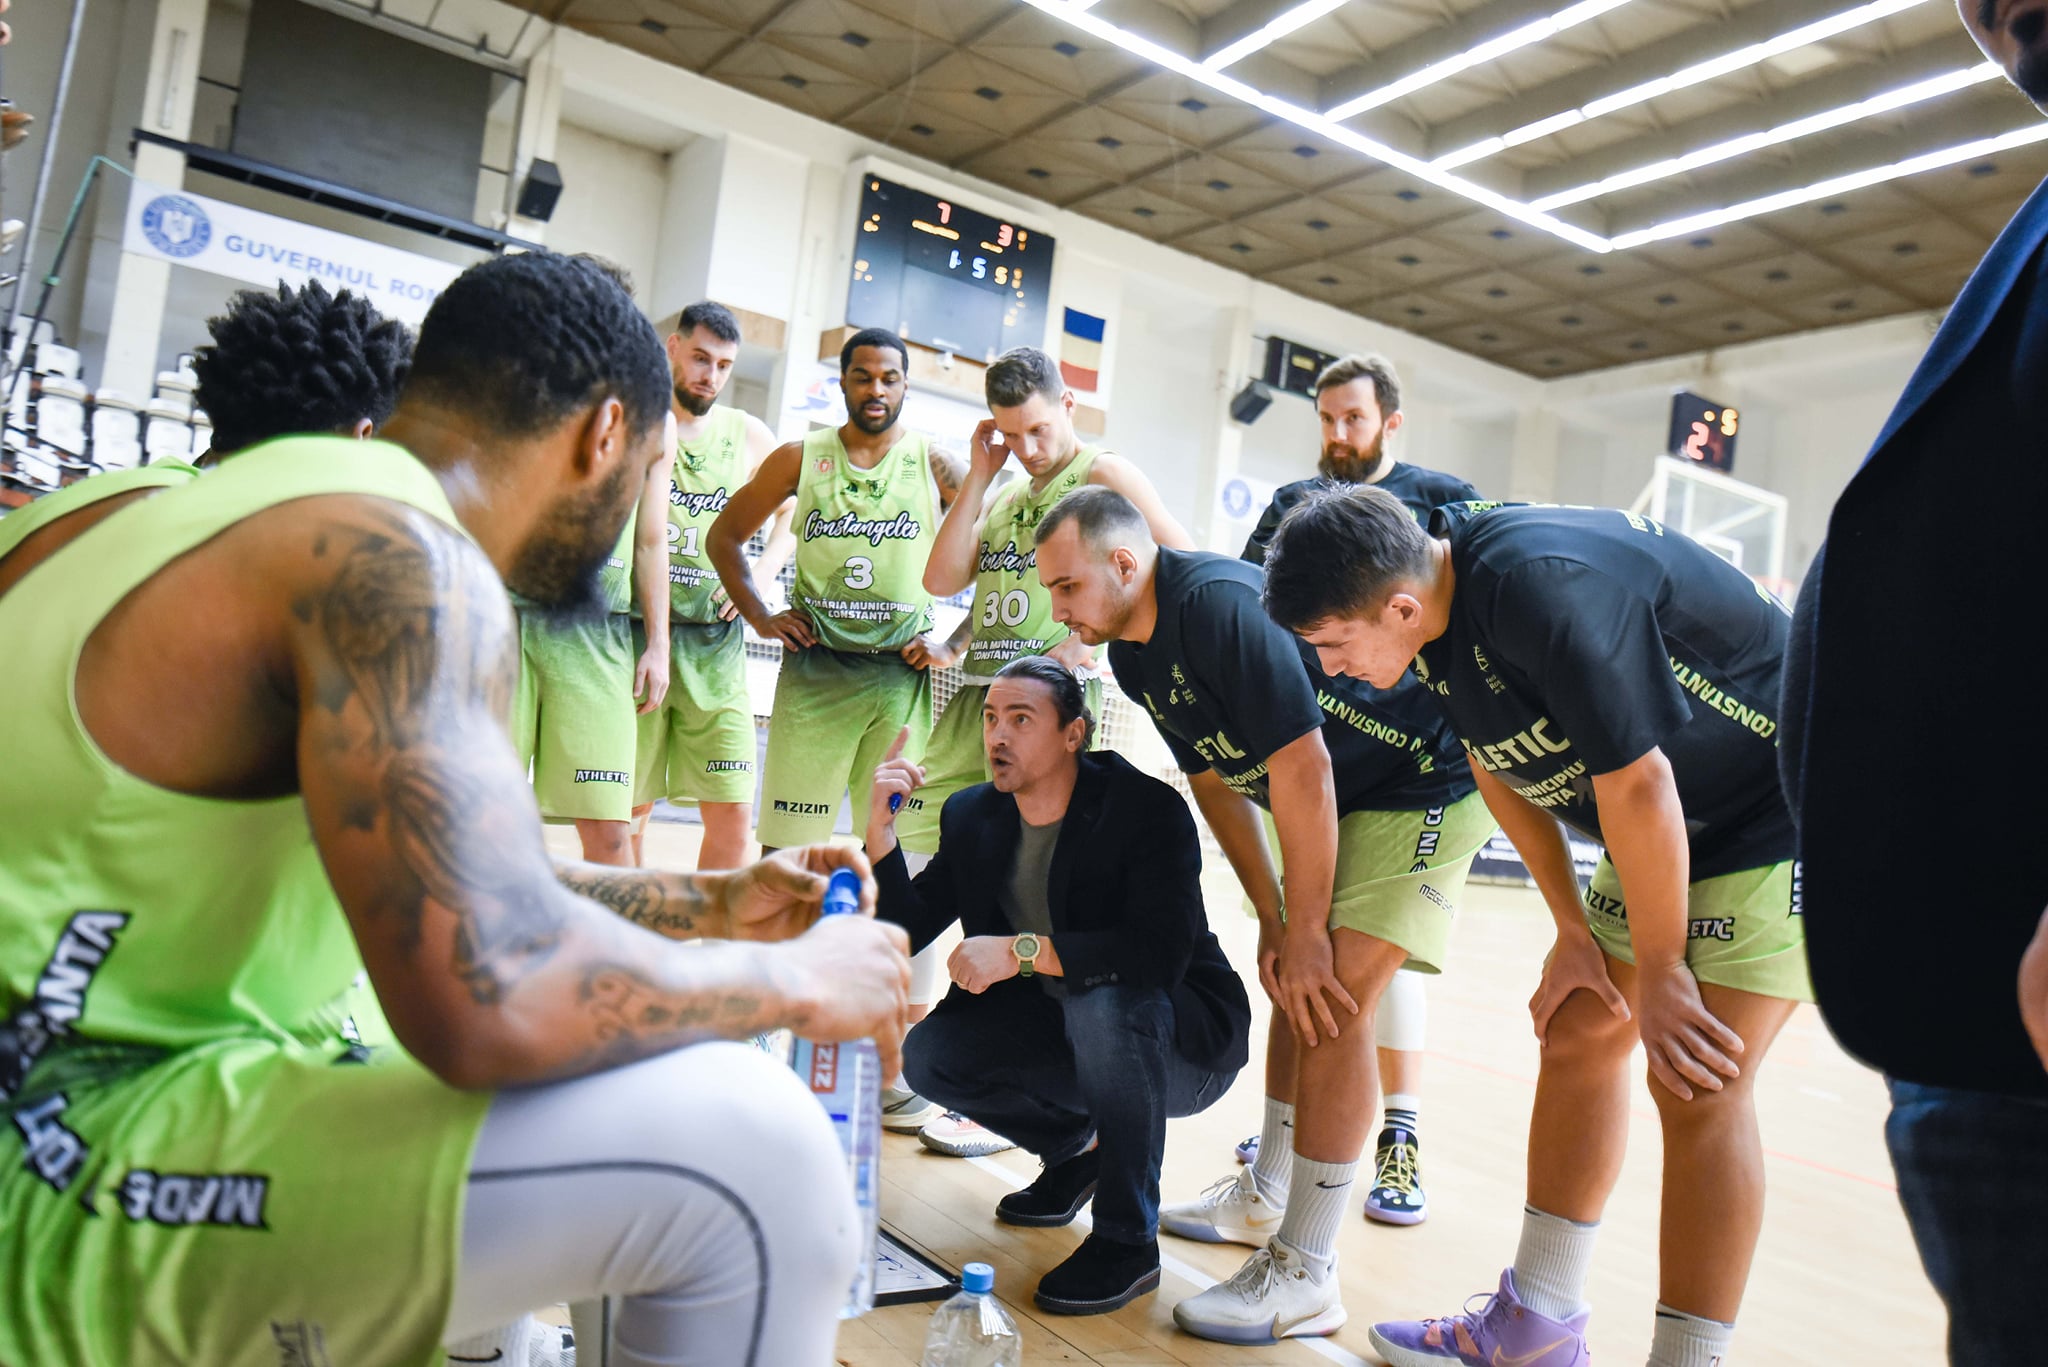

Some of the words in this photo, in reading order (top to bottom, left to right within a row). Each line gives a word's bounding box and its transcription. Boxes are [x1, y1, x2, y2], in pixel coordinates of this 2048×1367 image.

[224, 234, 379, 290] GUVERNUL
[667, 522, 700, 558] 21
[804, 510, 920, 546] Constangeles
[843, 555, 875, 590] 3
[982, 589, 1030, 628] 30
[575, 769, 630, 786] ATHLETIC
